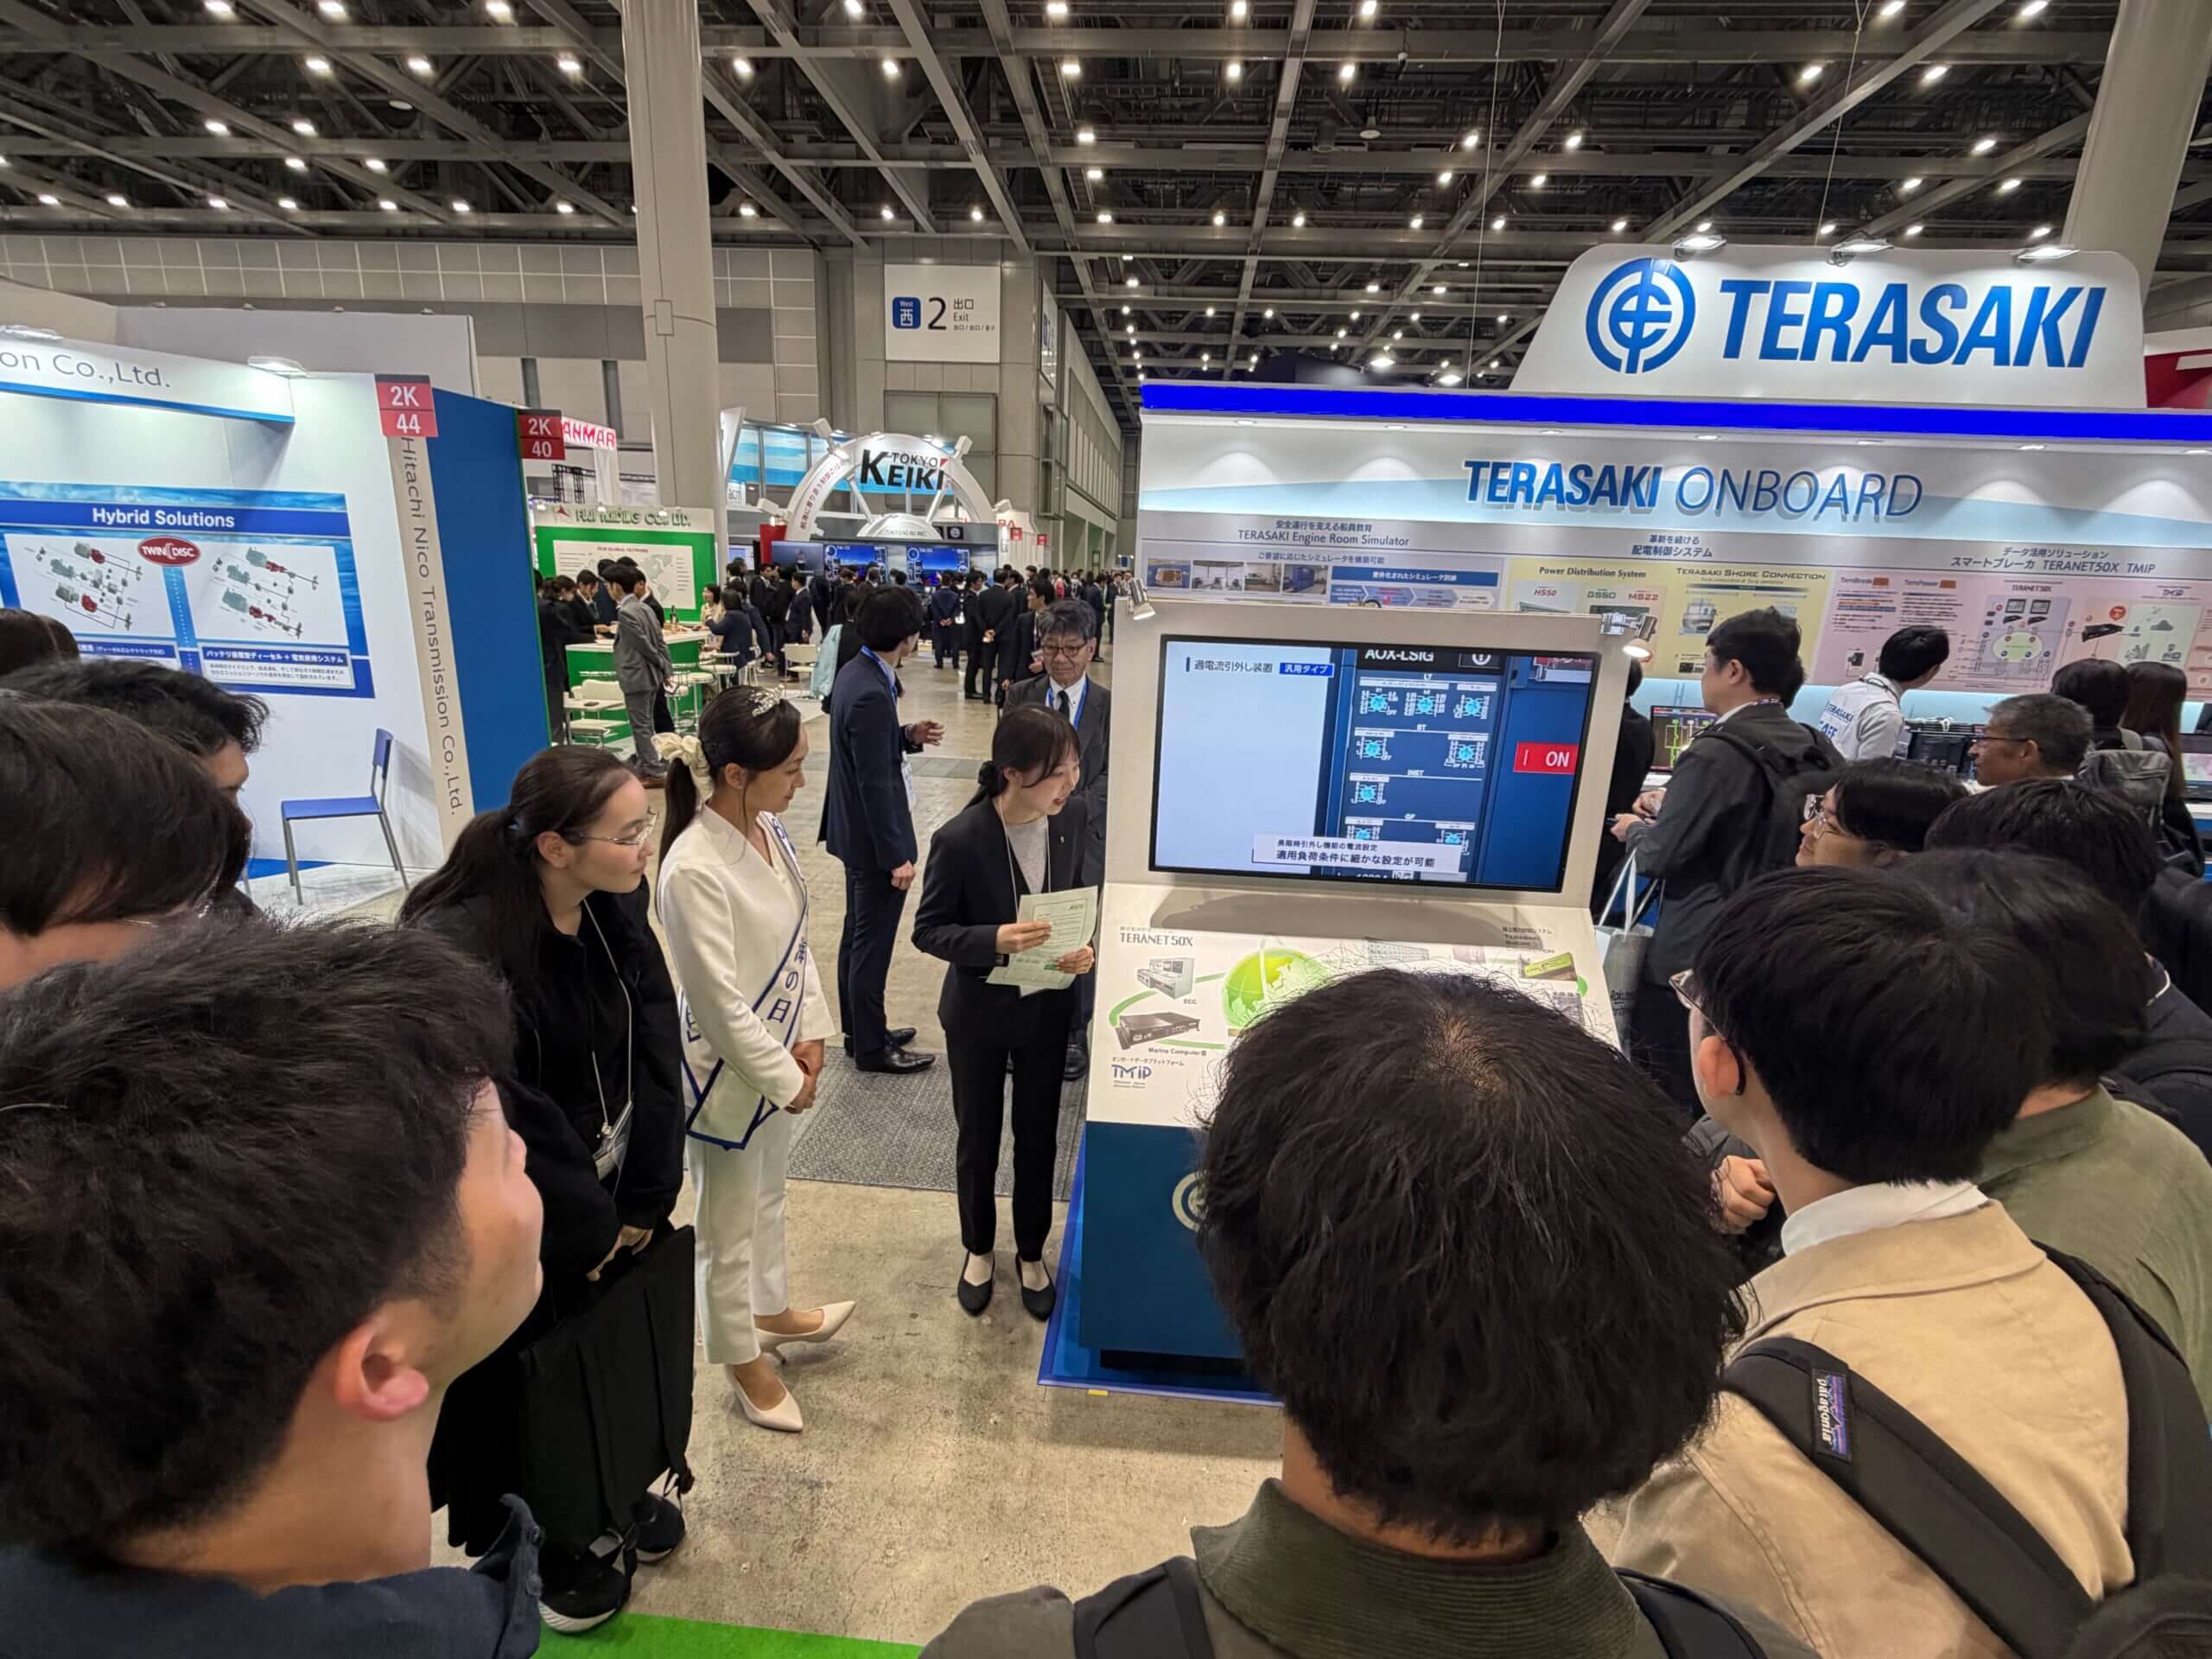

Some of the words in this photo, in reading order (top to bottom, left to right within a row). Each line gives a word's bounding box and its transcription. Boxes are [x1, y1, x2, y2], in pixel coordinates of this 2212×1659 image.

[954, 298, 974, 309] 出口
[900, 308, 912, 326] 西
[928, 297, 947, 330] 2
[954, 313, 969, 322] Exit
[1719, 279, 2106, 368] TERASAKI
[53, 354, 170, 388] Co.,Ltd.
[391, 386, 419, 407] 2K
[397, 414, 421, 434] 44
[528, 418, 552, 436] 2K
[532, 442, 553, 457] 40
[892, 453, 938, 467] TOKYO
[400, 436, 425, 518] Hitachi
[861, 449, 944, 490] KEIKI
[1464, 461, 1664, 508] TERASAKI
[1676, 467, 1923, 517] ONBOARD
[92, 507, 149, 525] Hybrid
[155, 510, 235, 528] Solutions
[1237, 530, 1289, 542] TERASAKI
[1293, 532, 1326, 545] Engine
[1329, 534, 1358, 544] Room
[1361, 535, 1409, 546] Simulator
[142, 545, 167, 556] TWIN
[172, 547, 196, 557] DISC
[413, 526, 430, 578] Nico
[1631, 544, 1713, 557] 配電制御システム
[1567, 567, 1616, 577] Distribution
[1618, 569, 1646, 579] System
[1676, 567, 1721, 576] TERASAKI
[1762, 570, 1826, 580] CONNECTION
[1951, 557, 2035, 569] スマートブレーカ
[2043, 560, 2119, 573] TERANET50X
[1534, 588, 1557, 596] HS50
[1628, 593, 1658, 601] MS22
[421, 586, 450, 728] Transmission
[1545, 751, 1570, 767] ON
[1816, 1377, 1833, 1446] patagonia
